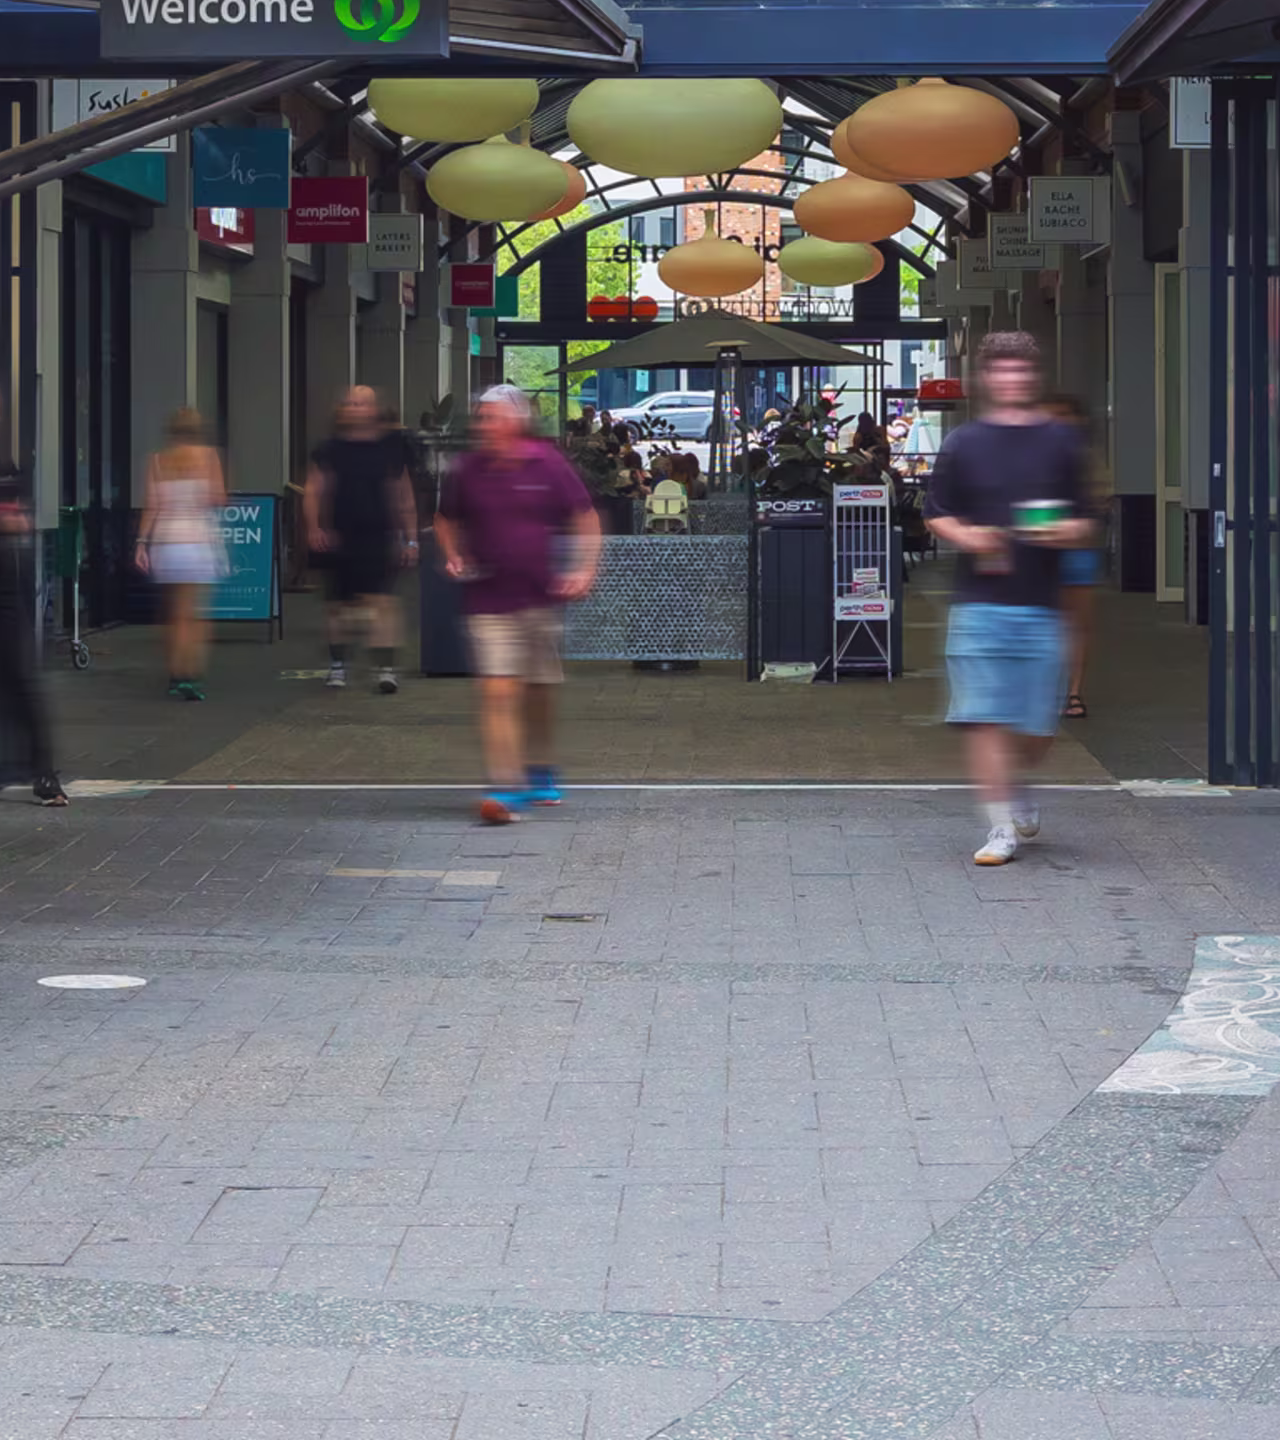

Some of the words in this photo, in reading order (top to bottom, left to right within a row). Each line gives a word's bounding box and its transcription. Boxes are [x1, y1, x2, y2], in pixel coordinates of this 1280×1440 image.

[1051, 192, 1074, 201] ELLA
[295, 203, 360, 220] amplifon
[1040, 219, 1088, 228] SUBIACO
[375, 233, 411, 241] LAYERS
[375, 244, 412, 252] BAKERY
[996, 249, 1041, 257] MASSAGE
[756, 500, 816, 513] POST
[223, 505, 260, 522] OW
[222, 527, 261, 544] PEN
